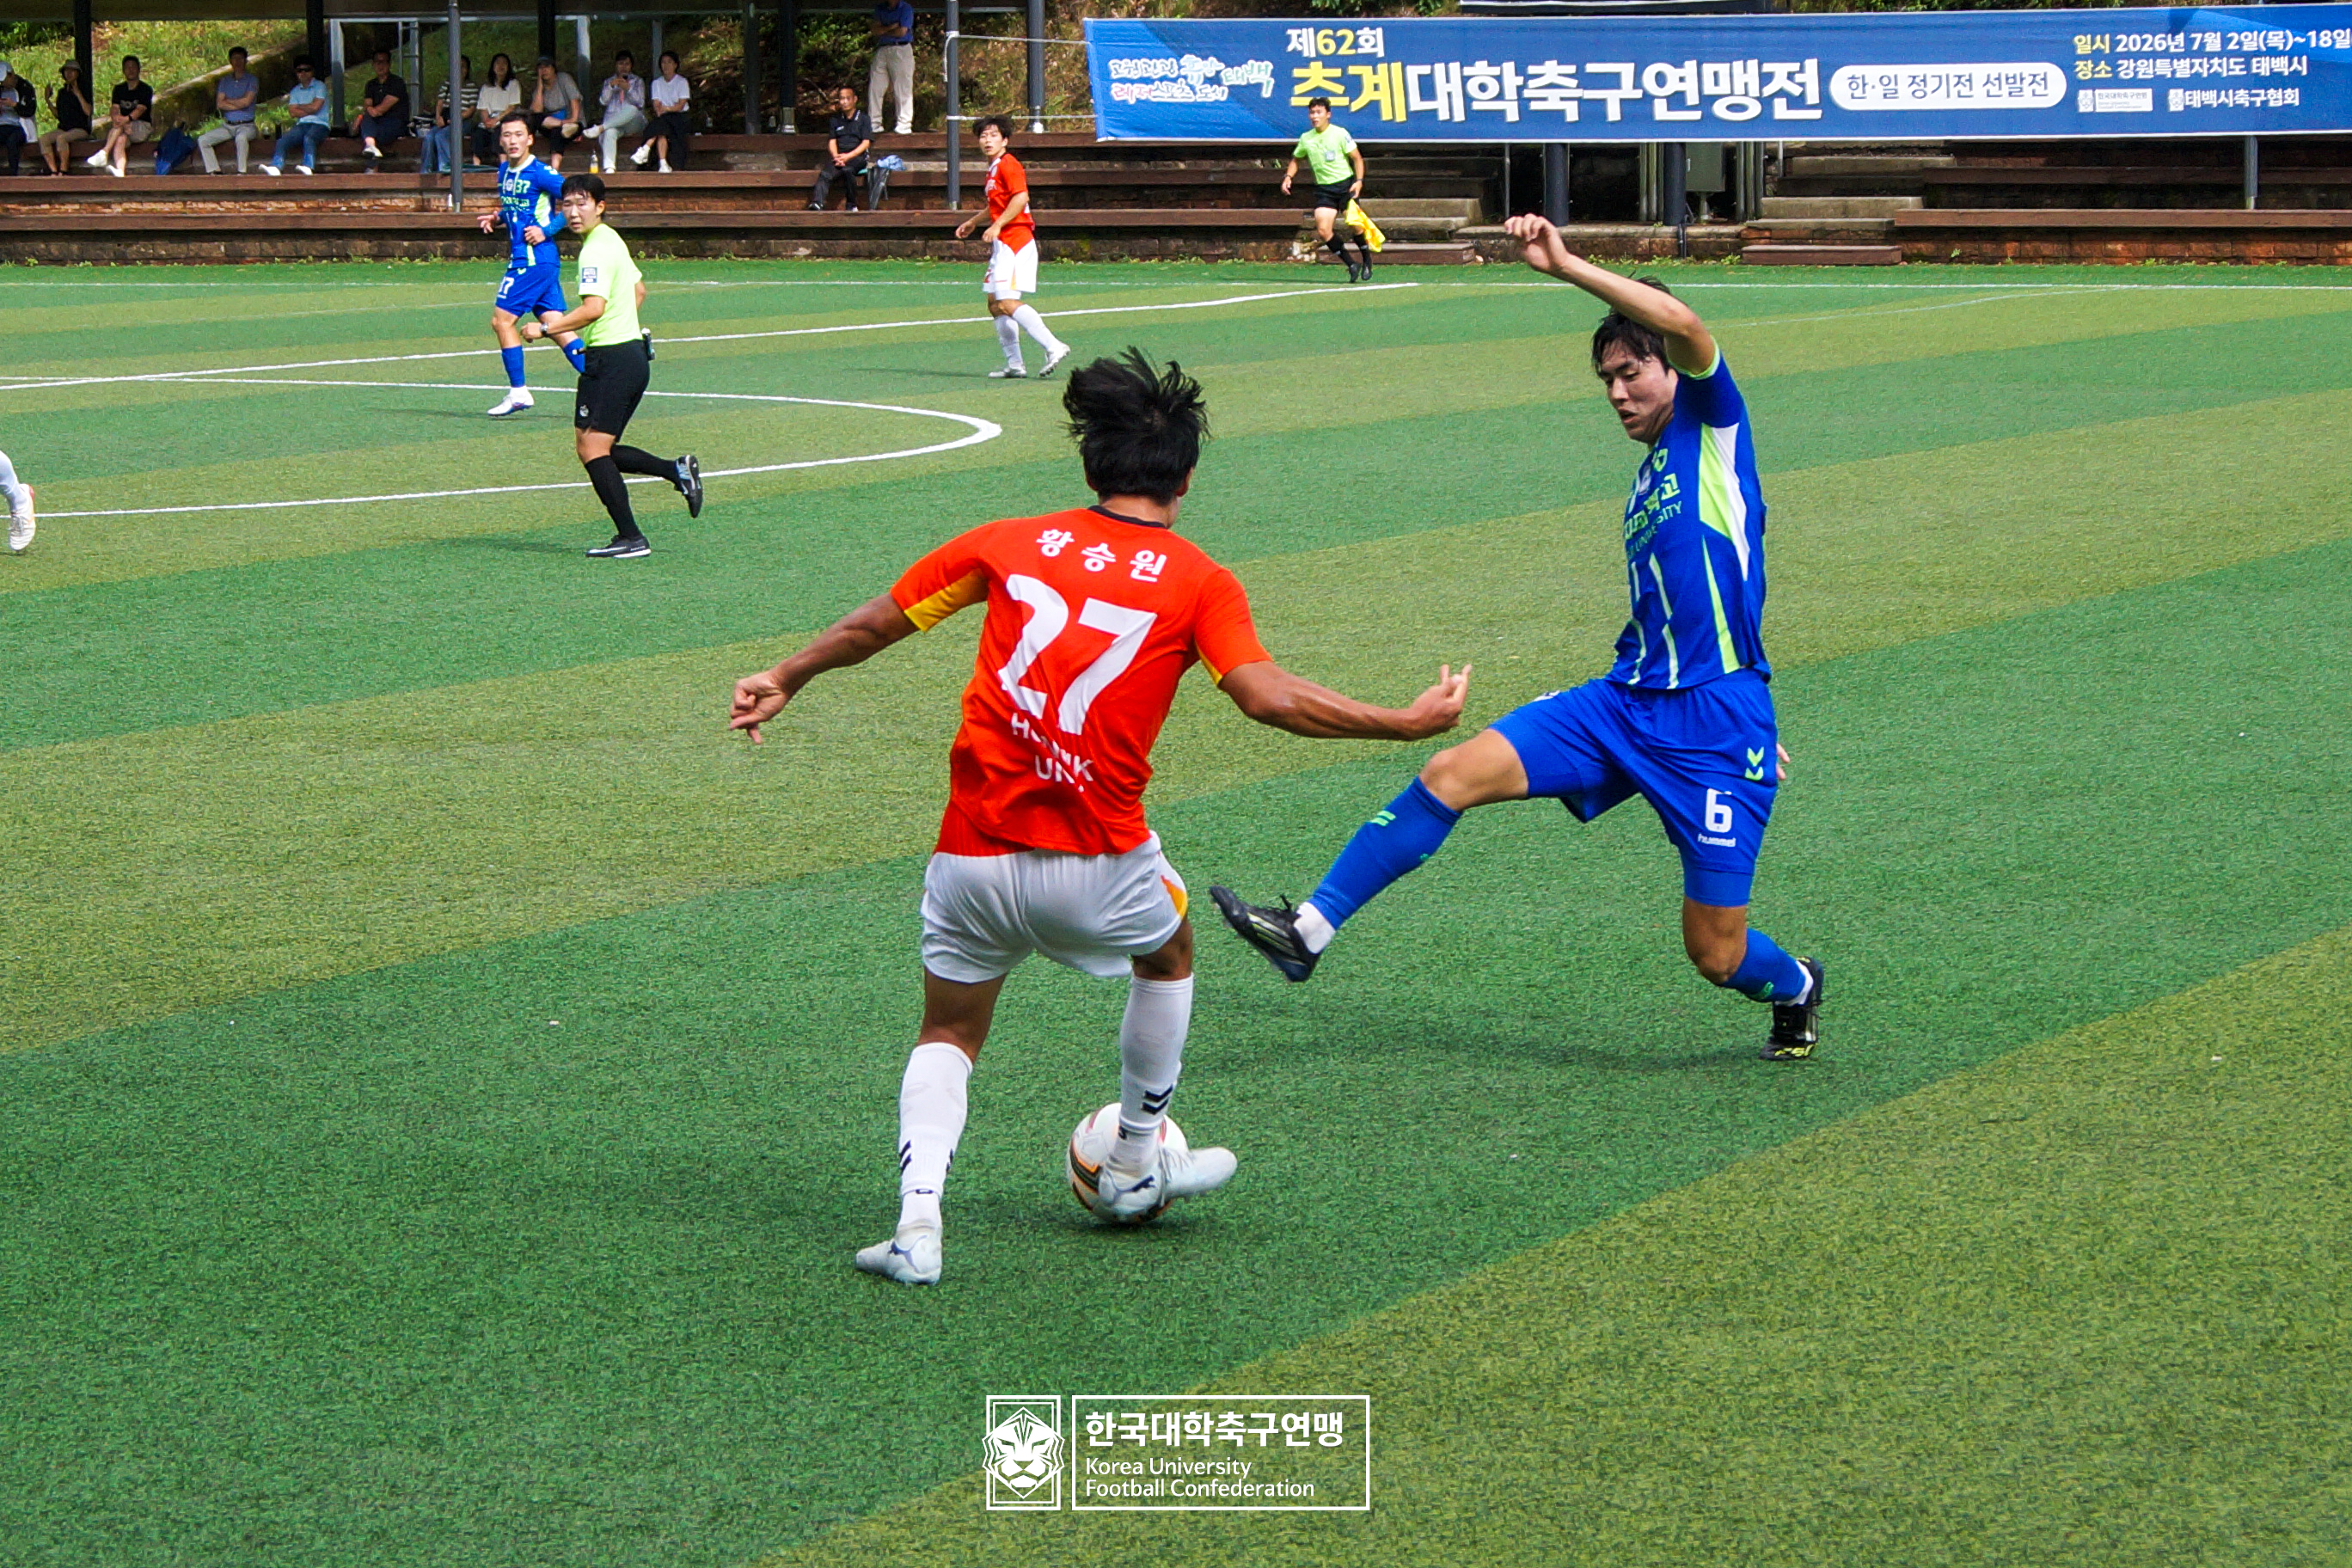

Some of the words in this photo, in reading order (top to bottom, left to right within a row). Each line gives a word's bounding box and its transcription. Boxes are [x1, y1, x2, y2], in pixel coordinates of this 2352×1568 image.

[1286, 27, 1385, 58] 제62회
[2073, 34, 2110, 54] 일시
[2115, 32, 2185, 52] 2026년
[2190, 32, 2221, 52] 7월
[1221, 60, 1274, 97] 태백
[2074, 59, 2112, 79] 장소
[2116, 57, 2246, 78] 강원특별자치도
[2251, 55, 2307, 77] 태백시
[1847, 74, 1900, 100] 한·일
[1908, 73, 1974, 99] 정기전
[1982, 71, 2049, 97] 선발전
[2184, 89, 2300, 108] 태백시축구협회
[997, 573, 1157, 736] 27
[1705, 787, 1732, 833] 6
